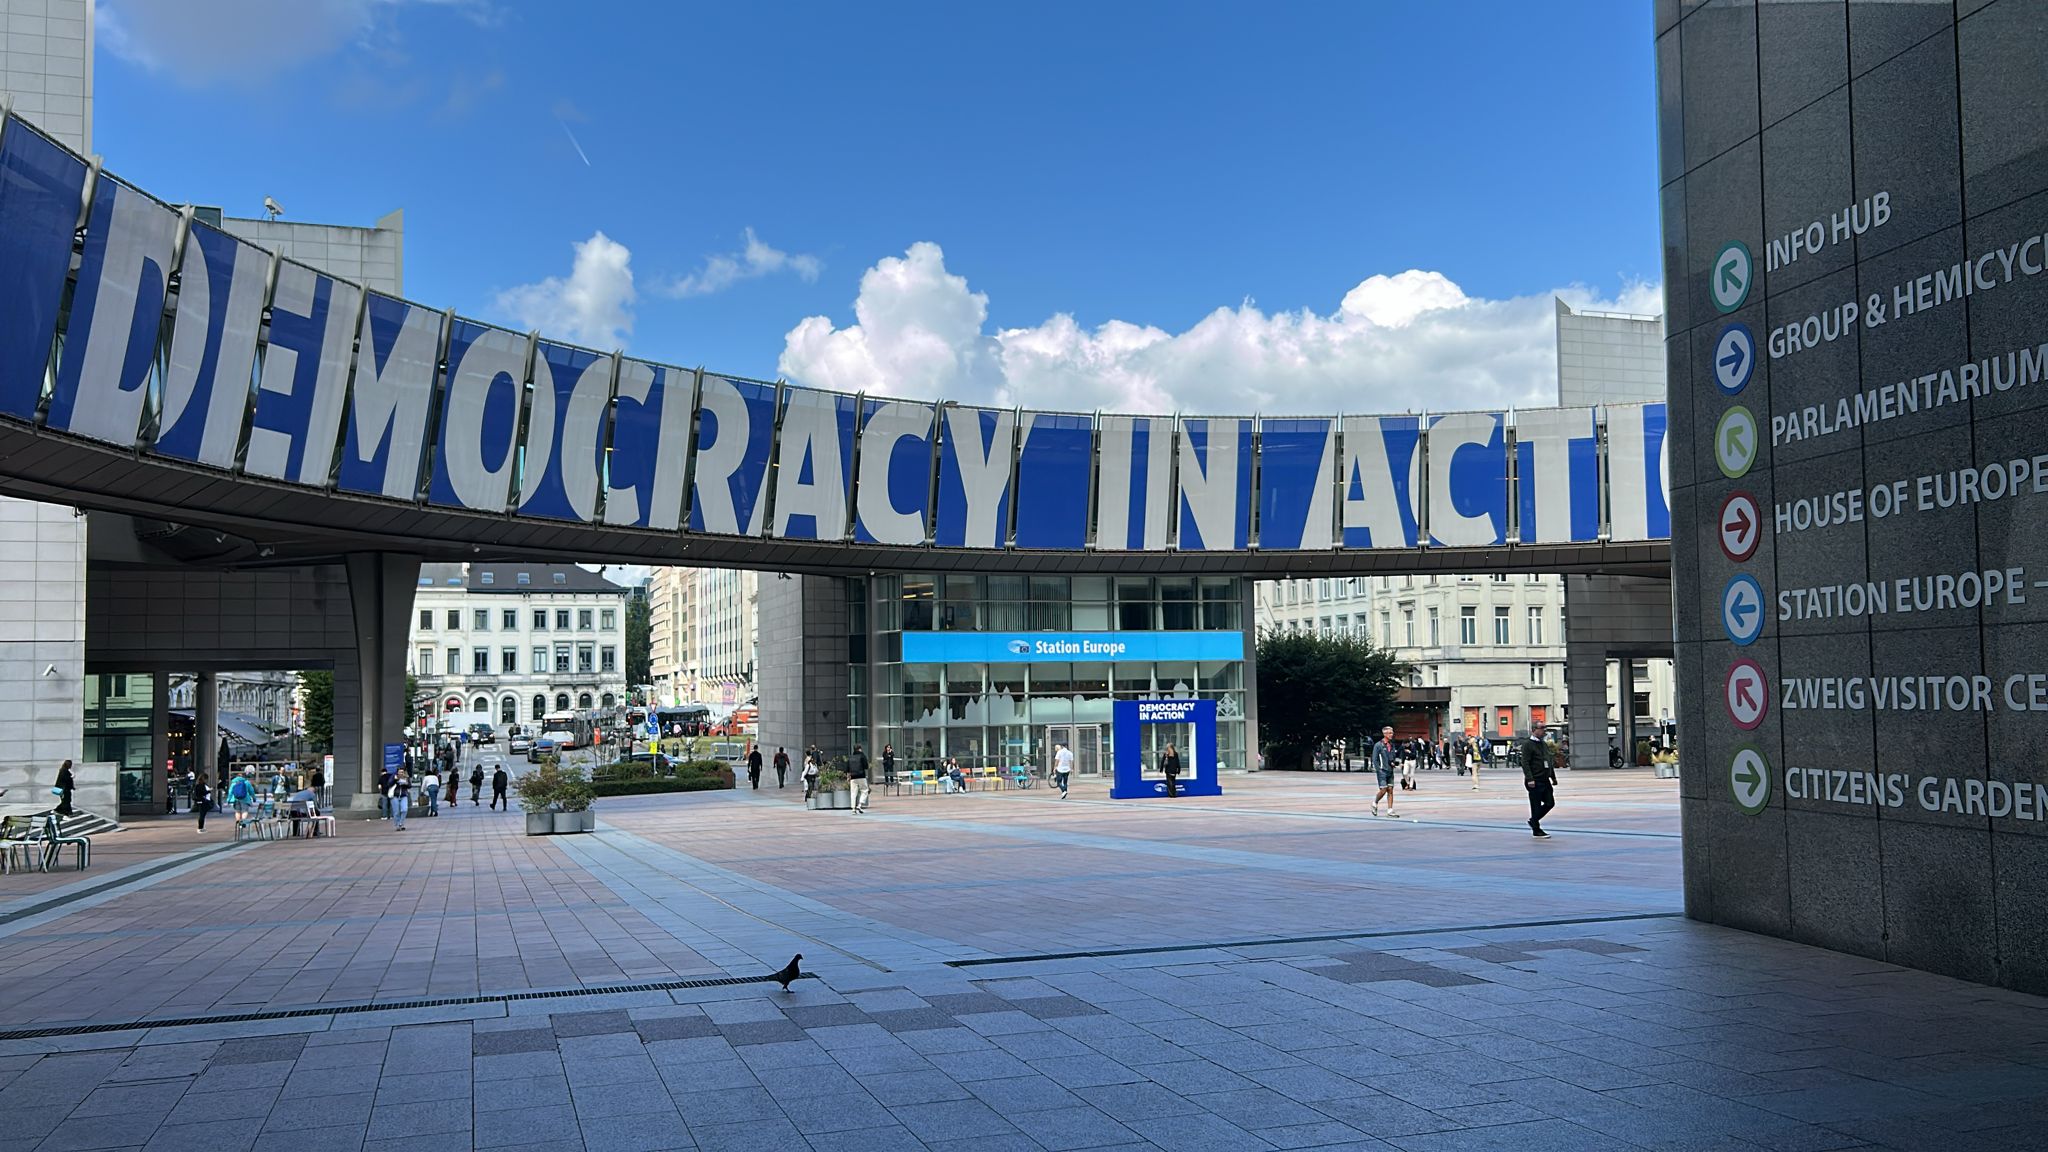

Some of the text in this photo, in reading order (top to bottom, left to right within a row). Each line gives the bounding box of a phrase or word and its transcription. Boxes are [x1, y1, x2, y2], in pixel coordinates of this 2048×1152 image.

[1766, 191, 1891, 272] INFO HUB
[1769, 233, 2048, 359] GROUP & HEMICYC
[68, 184, 1670, 550] DEMOCRACY IN ACTI
[1772, 343, 2048, 446] PARLAMENTARIUM
[1776, 489, 1863, 534] HOUSE
[1870, 482, 1908, 518] OF
[1779, 581, 1887, 621] STATION
[1896, 567, 2026, 612] EUROPE
[1036, 640, 1125, 656] Station Europe
[1139, 702, 1195, 712] DEMOCRACY
[1139, 711, 1185, 720] IN ACTION
[1782, 677, 1864, 710] ZWEIG
[1870, 675, 1994, 711] VISITOR
[1785, 767, 1909, 808] CITIZENS'
